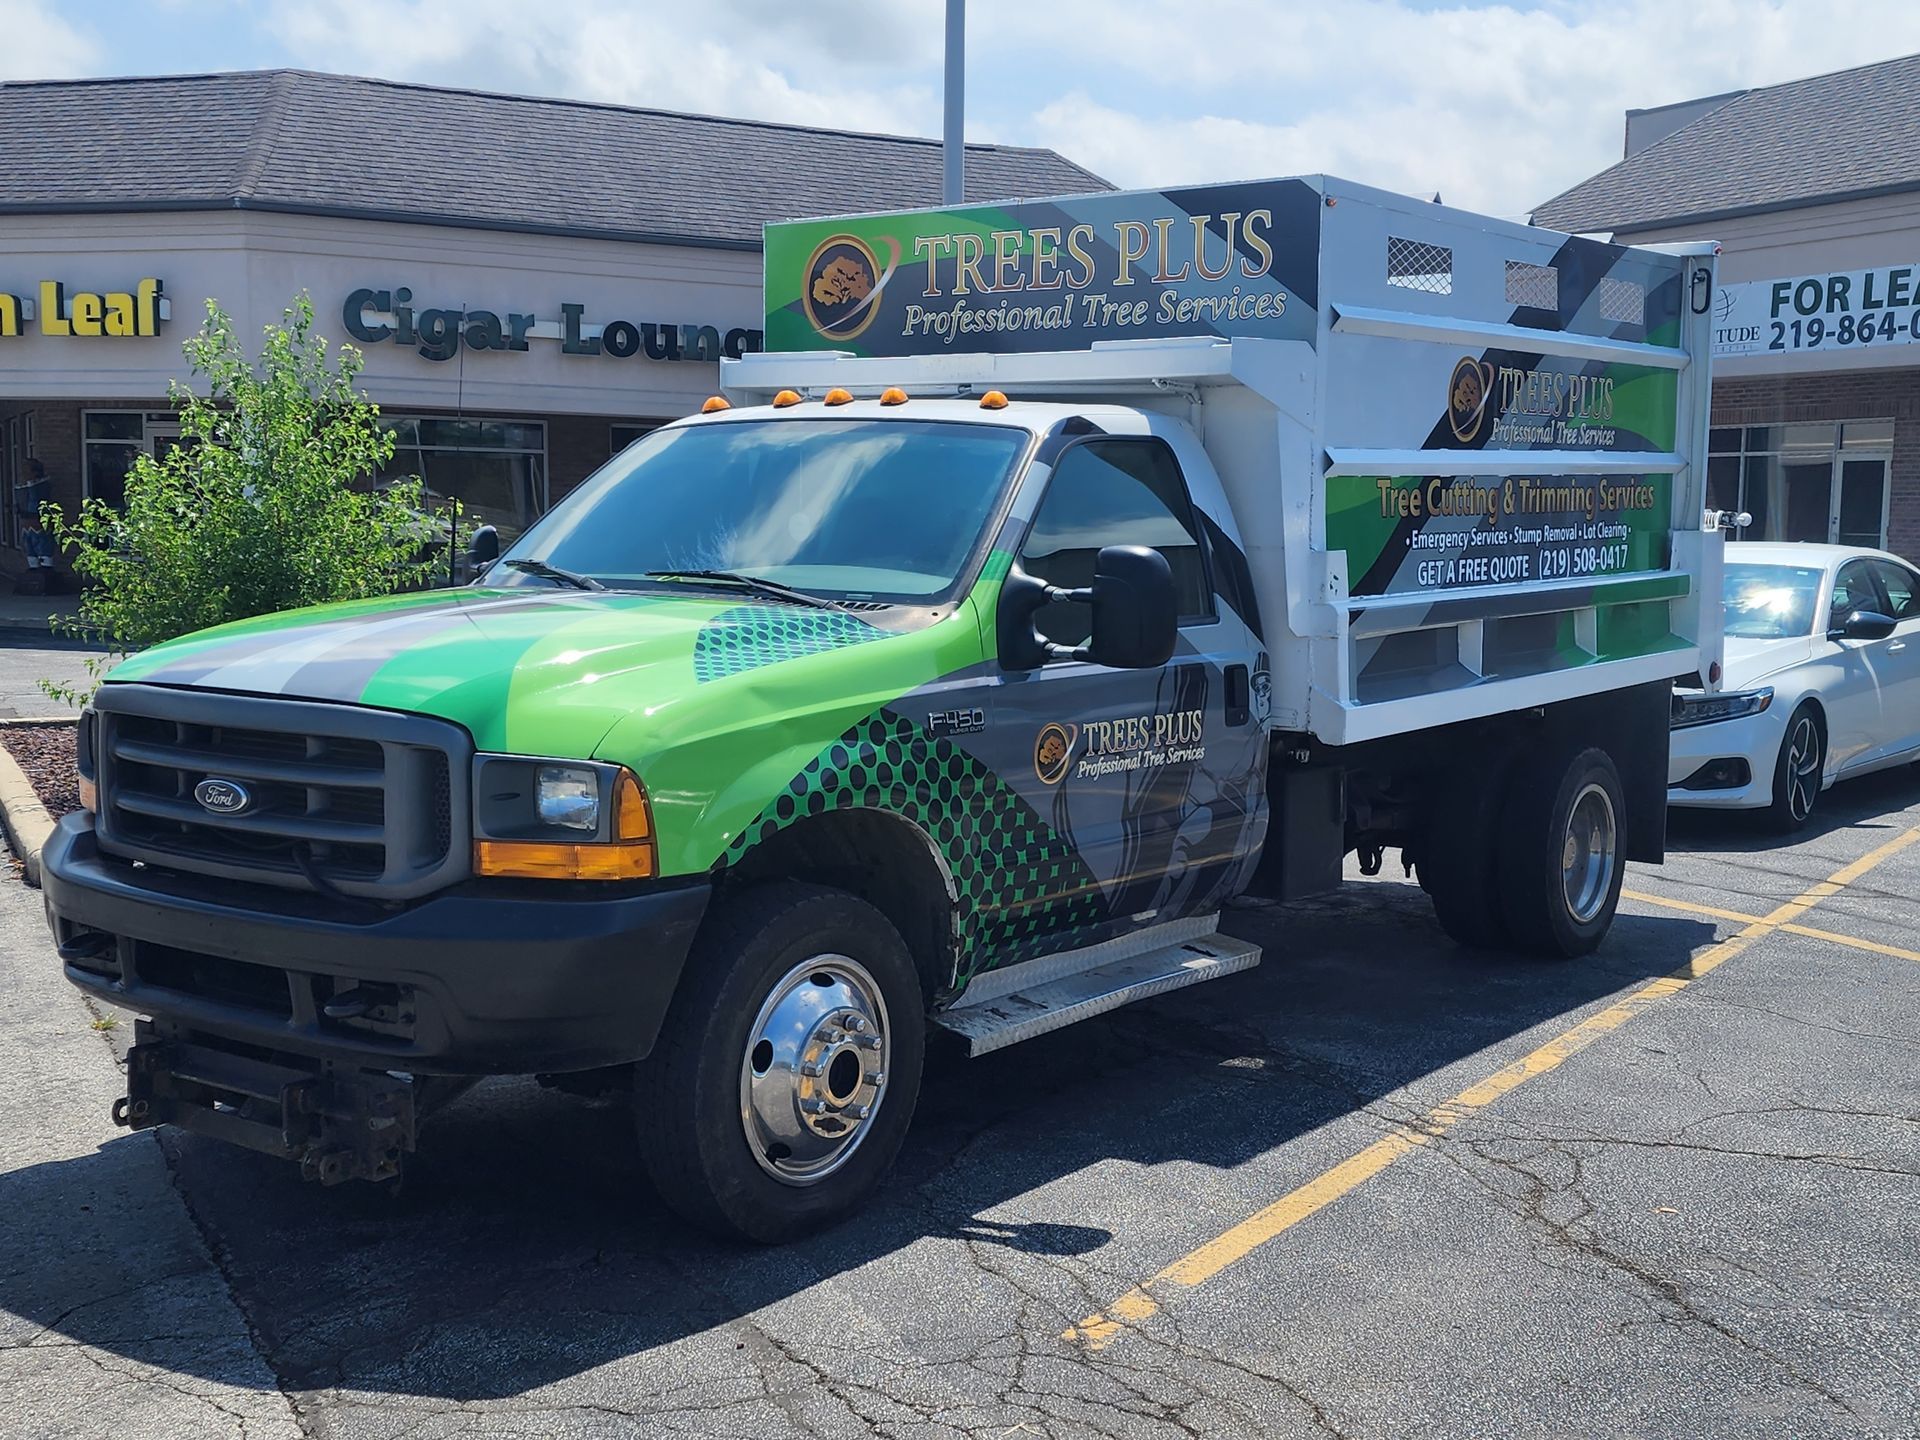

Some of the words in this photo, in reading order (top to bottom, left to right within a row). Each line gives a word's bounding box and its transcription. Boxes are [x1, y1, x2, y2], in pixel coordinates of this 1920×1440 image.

[914, 223, 1096, 298] TREES
[1112, 208, 1274, 287] PLUS
[40, 277, 163, 337] Leaf
[901, 293, 1076, 345] Professional
[1081, 293, 1149, 328] Tree
[1155, 286, 1288, 324] Services
[1770, 276, 1851, 319] FOR
[342, 286, 535, 362] Cigar
[1499, 366, 1564, 418] TREES
[1567, 374, 1614, 420] PLUS
[1490, 417, 1555, 449] Professional
[1556, 421, 1577, 445] Tree
[1579, 422, 1616, 447] Services
[1376, 478, 1422, 517] Tree
[1426, 478, 1499, 525] Cutting
[1503, 478, 1516, 515] &
[1519, 478, 1595, 521] Trimming
[1599, 477, 1655, 512] Services
[1411, 529, 1470, 553] Emergency
[1470, 526, 1508, 547] Services
[1513, 525, 1542, 547] Stump
[1543, 523, 1577, 543] Removal
[1583, 522, 1597, 540] Lot
[1597, 521, 1627, 541] Clearing
[1418, 559, 1444, 586] GET
[1445, 560, 1456, 584] A
[1458, 557, 1488, 583] FREE
[1490, 555, 1530, 582] QUOTE
[1539, 547, 1570, 580] (219)
[1573, 544, 1629, 574] 508-0417
[1083, 716, 1150, 757] TREES
[1154, 709, 1203, 747] PLUS
[1077, 751, 1142, 782] Professional
[1143, 750, 1165, 768] Tree
[1166, 744, 1206, 765] Services
[205, 785, 234, 807] Ford
